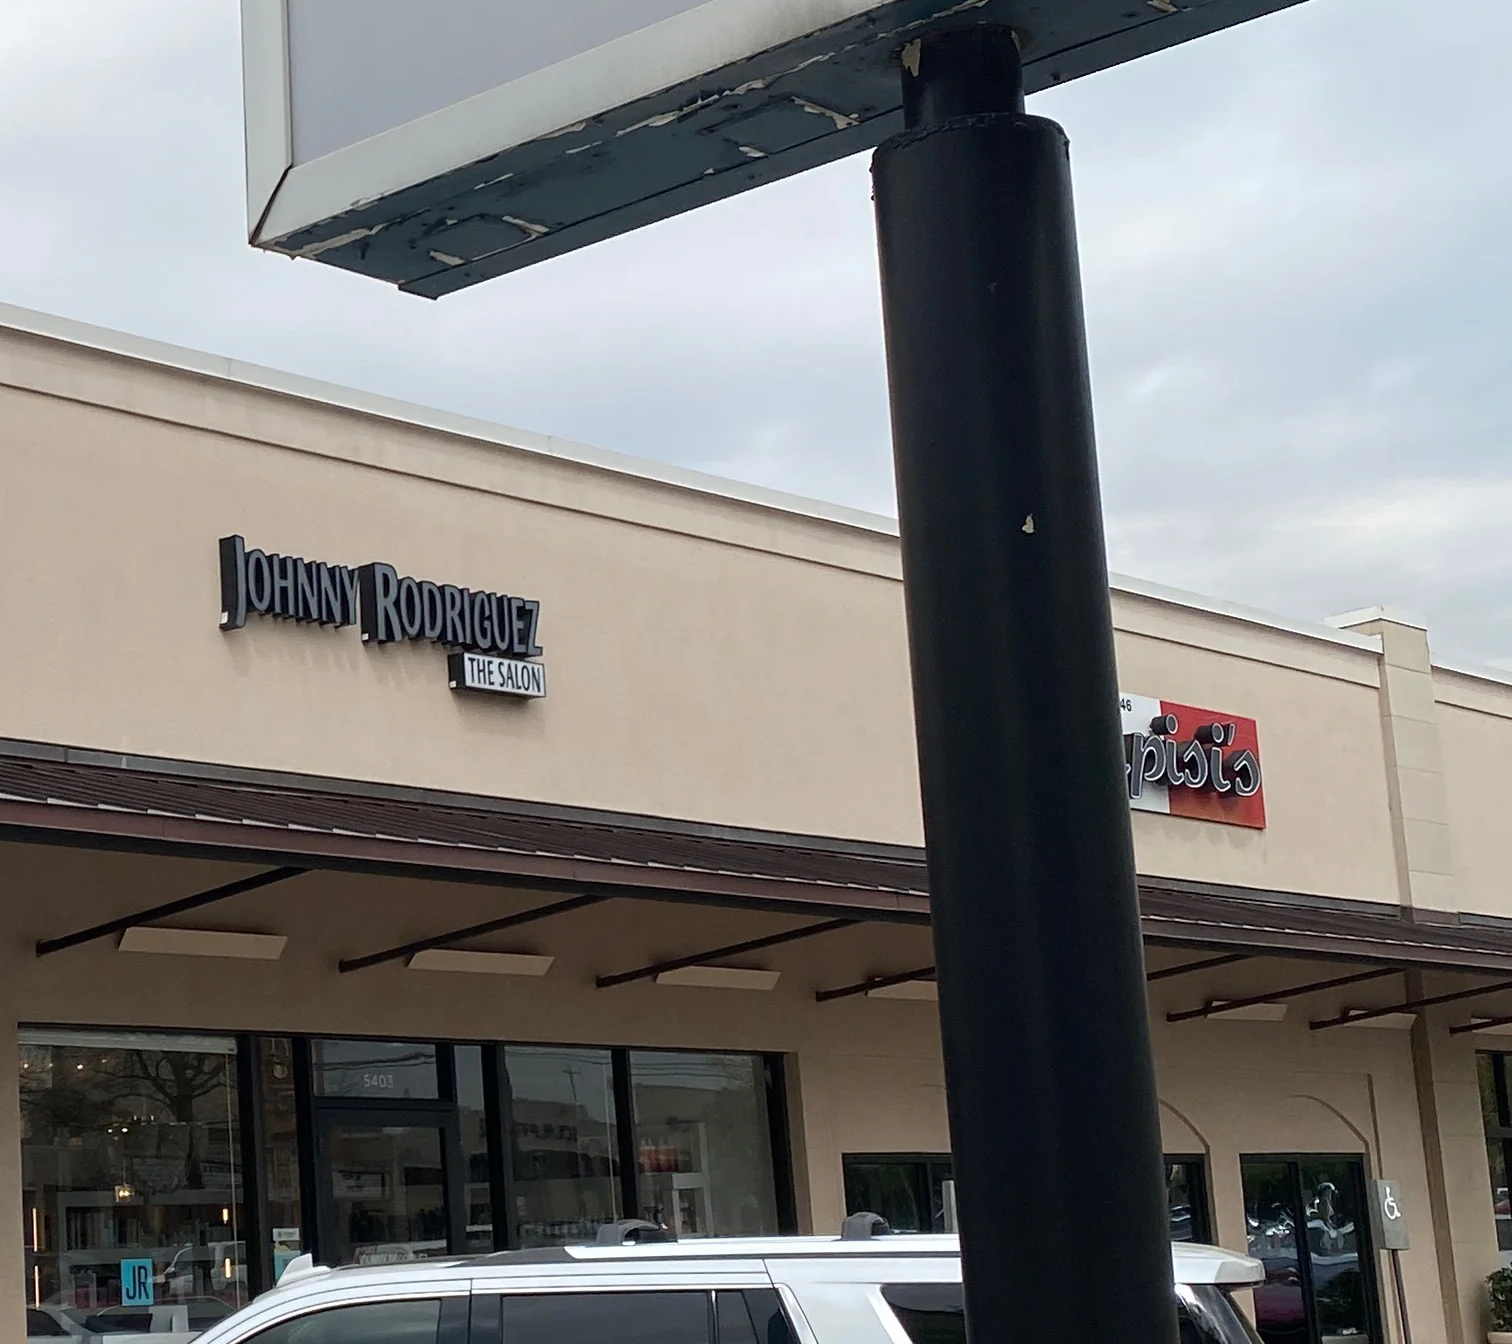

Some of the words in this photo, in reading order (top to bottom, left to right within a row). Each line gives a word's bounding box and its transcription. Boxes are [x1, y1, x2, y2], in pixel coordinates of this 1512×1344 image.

[219, 535, 359, 630] JOHNNY
[362, 562, 543, 655] RODRIGUEZ
[467, 657, 495, 686] THE
[498, 660, 542, 693] SALON
[1119, 697, 1132, 712] 46
[1124, 713, 1261, 798] pisi's
[363, 1073, 394, 1089] 5403
[126, 1265, 149, 1299] JR
